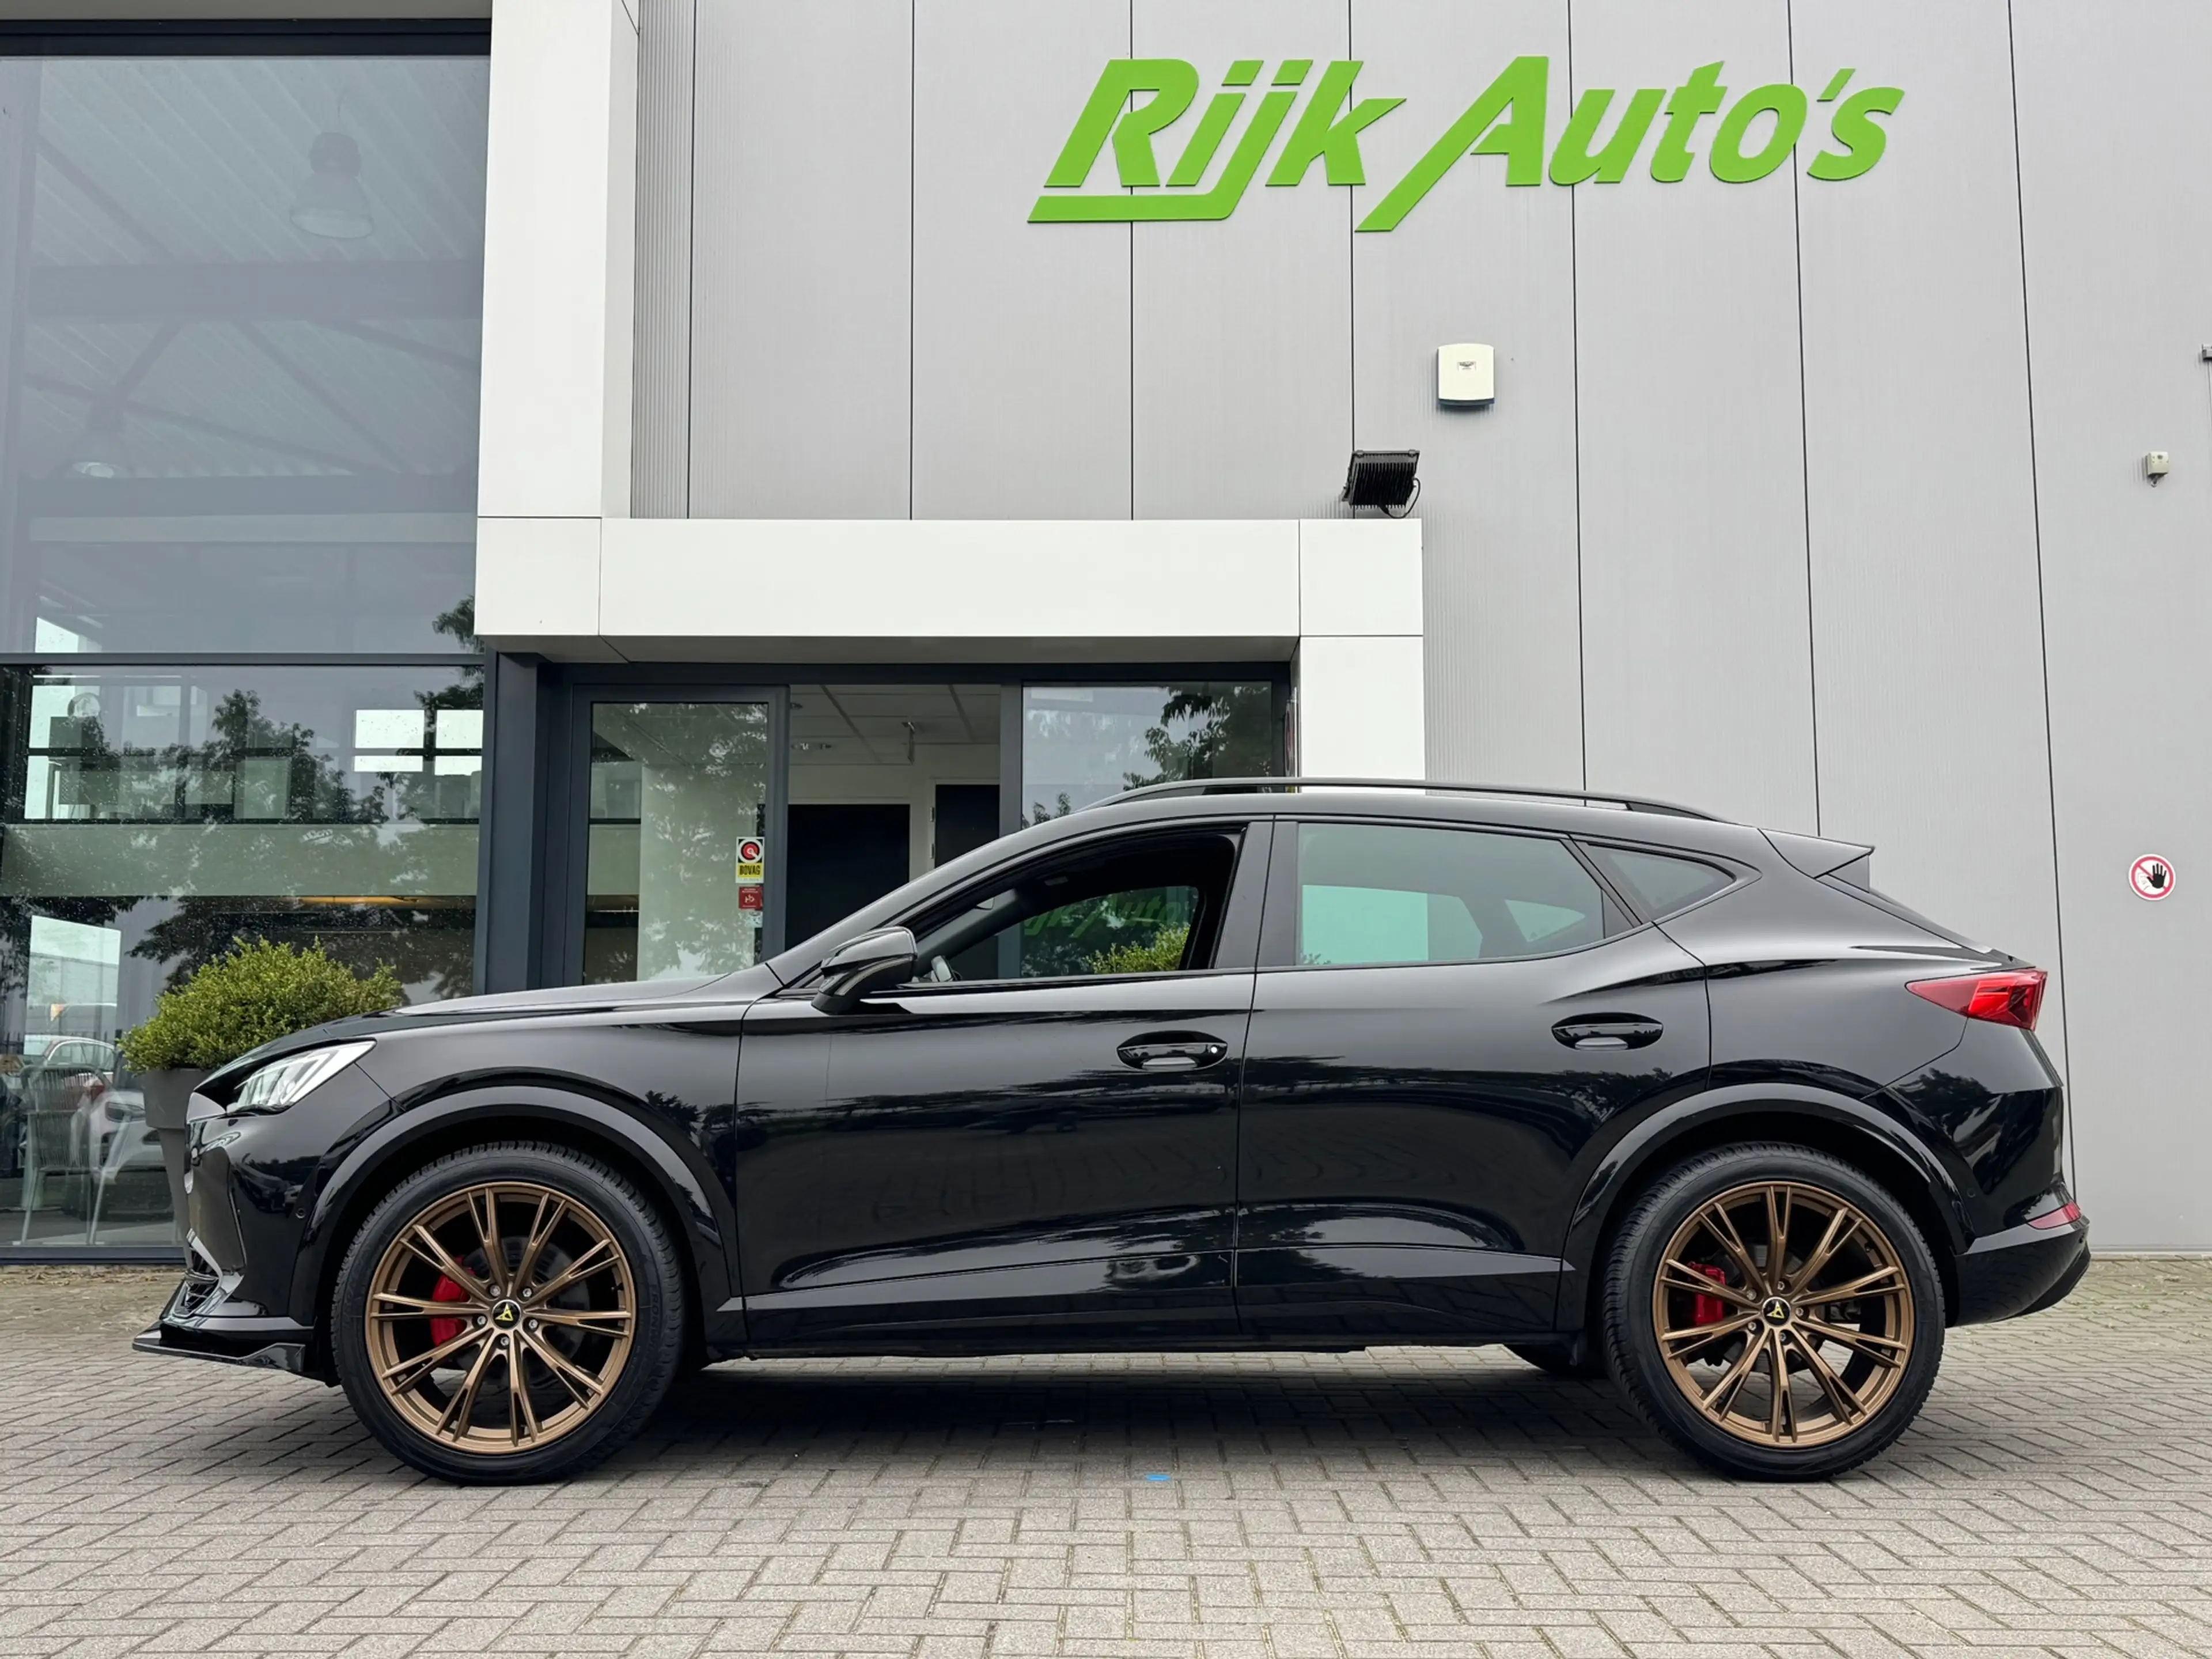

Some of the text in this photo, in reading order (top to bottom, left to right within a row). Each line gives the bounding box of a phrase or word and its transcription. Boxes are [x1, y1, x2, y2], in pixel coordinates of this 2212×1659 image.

[1029, 56, 1905, 232] Rijk Auto's
[739, 865, 760, 875] BOVAG
